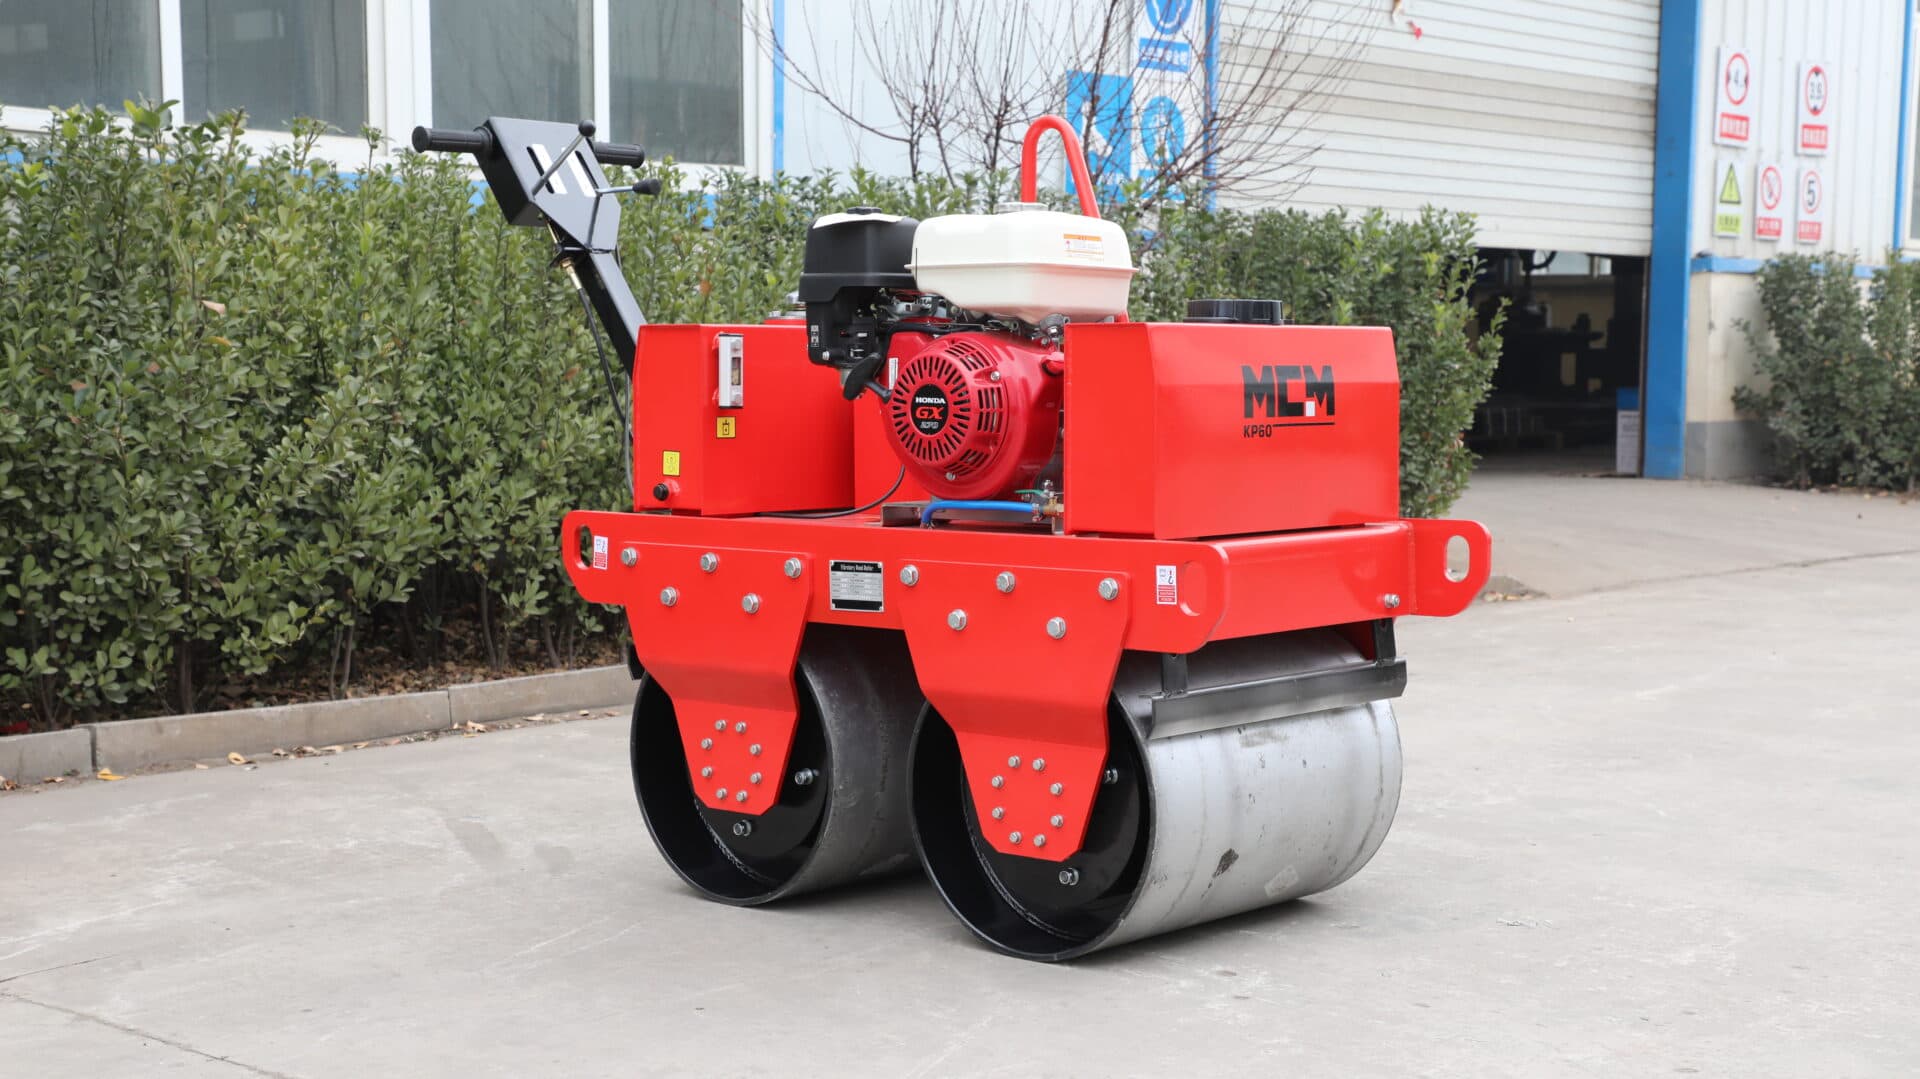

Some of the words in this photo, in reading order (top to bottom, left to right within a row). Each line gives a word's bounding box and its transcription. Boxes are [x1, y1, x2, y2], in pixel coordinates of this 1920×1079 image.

[1807, 180, 1815, 207] 5
[1242, 365, 1335, 417] MCM
[915, 406, 945, 420] GX
[1243, 424, 1272, 438] KP60
